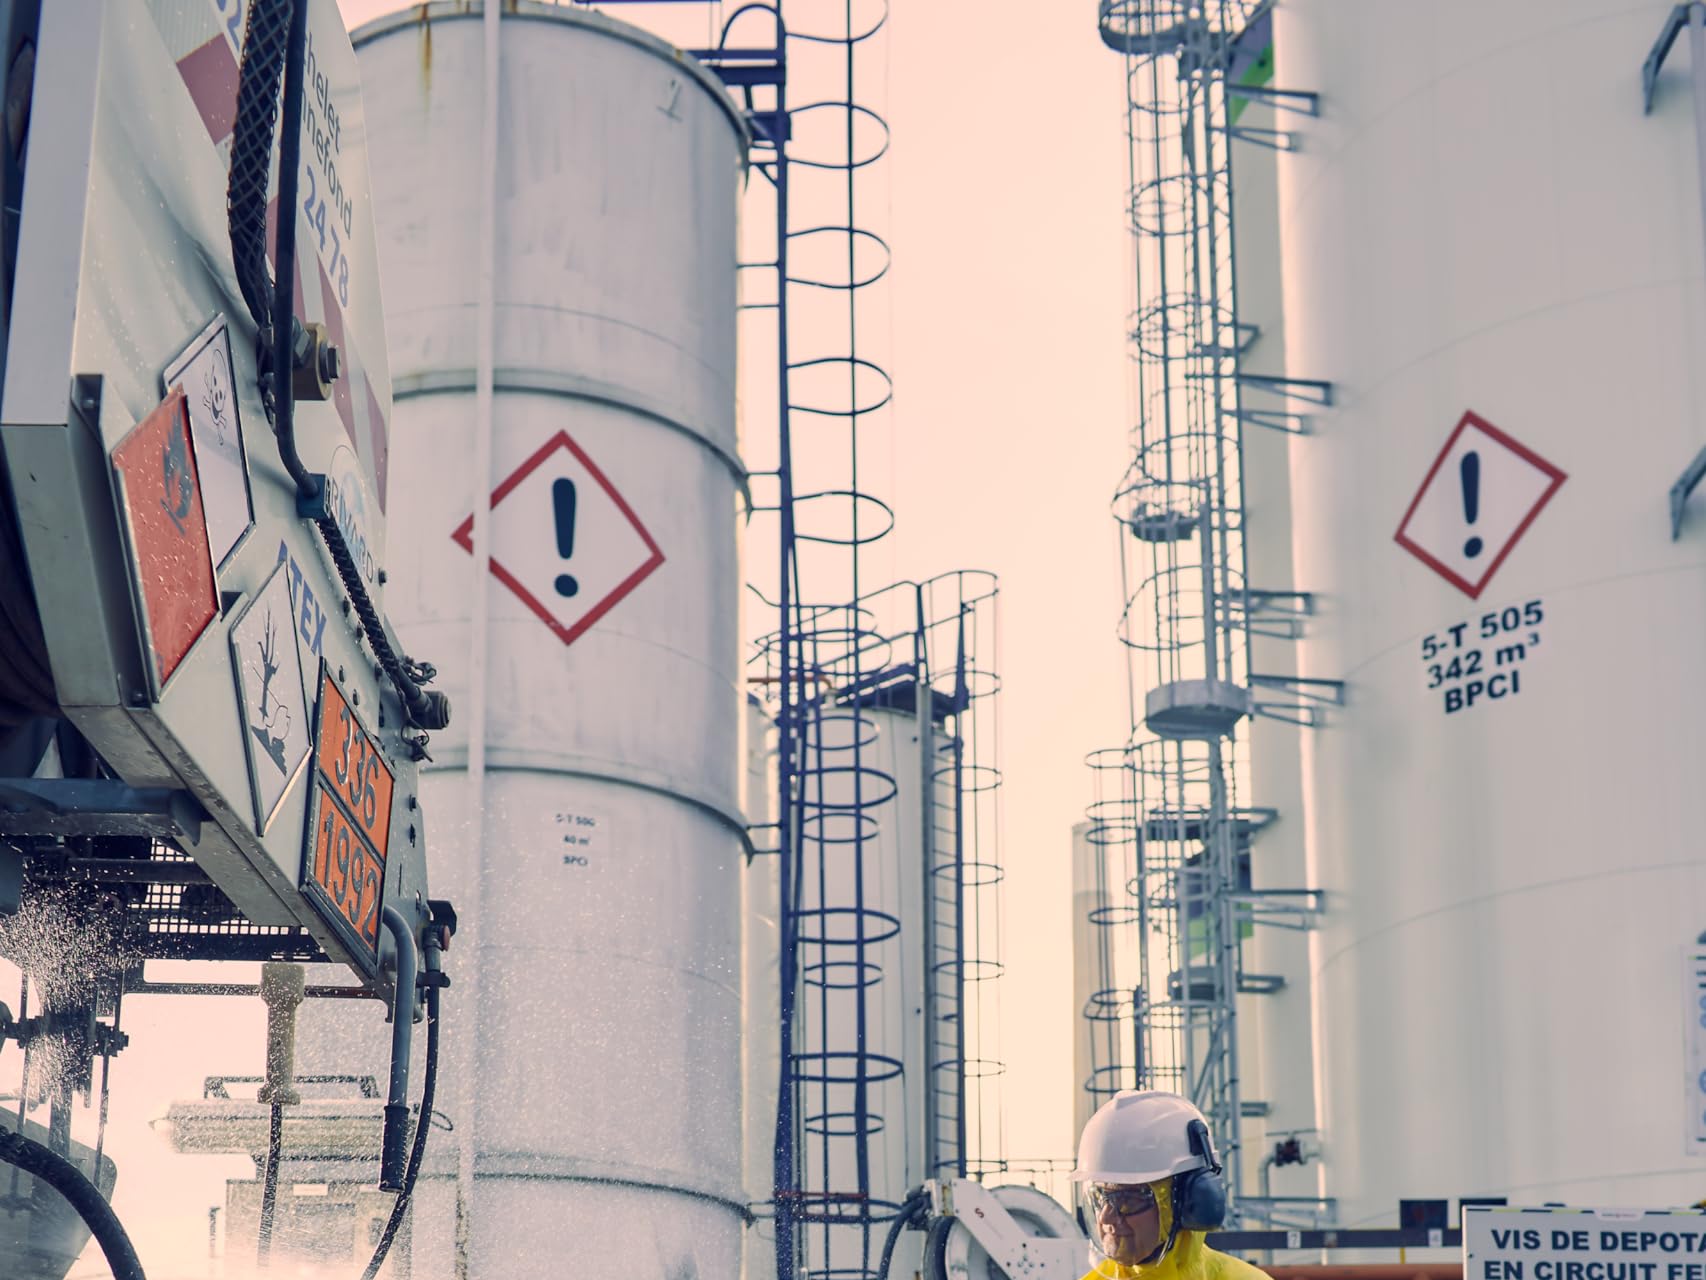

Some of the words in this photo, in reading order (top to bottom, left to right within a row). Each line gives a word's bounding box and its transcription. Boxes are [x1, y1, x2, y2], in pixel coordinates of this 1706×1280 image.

[305, 31, 341, 154] helet
[1422, 622, 1467, 660] 5-T
[1480, 600, 1543, 638] 505
[1428, 650, 1482, 688] 342
[1445, 669, 1519, 714] BPCI
[335, 705, 379, 830] 336
[323, 810, 379, 944] 1992
[1491, 1229, 1541, 1250] VIS
[1552, 1230, 1590, 1251] DE
[1484, 1260, 1524, 1280] EN
